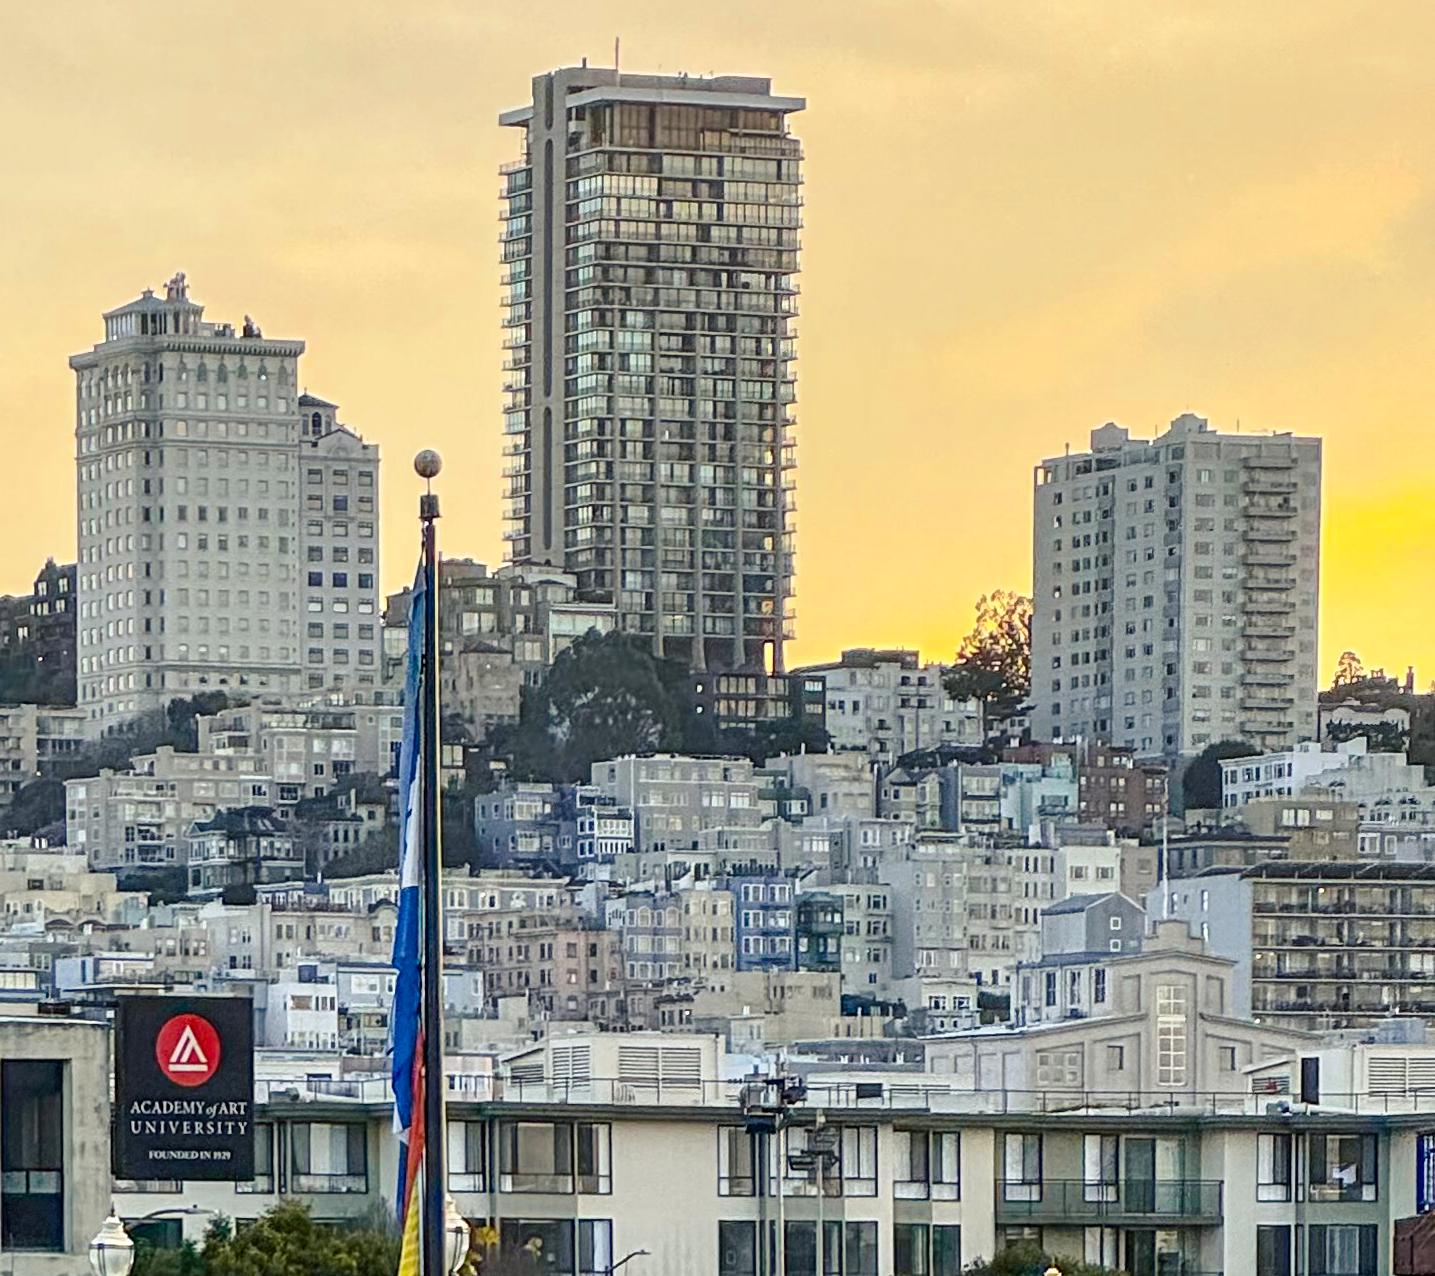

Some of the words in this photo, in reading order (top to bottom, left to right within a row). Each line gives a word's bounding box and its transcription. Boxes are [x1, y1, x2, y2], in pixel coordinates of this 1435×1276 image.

[130, 1100, 205, 1115] ACADEMY
[205, 1103, 219, 1119] of
[218, 1101, 248, 1115] ART
[130, 1120, 248, 1135] UNIVERSITY
[148, 1150, 199, 1160] FOUNDED
[200, 1150, 211, 1160] IN
[213, 1150, 232, 1160] 1929
